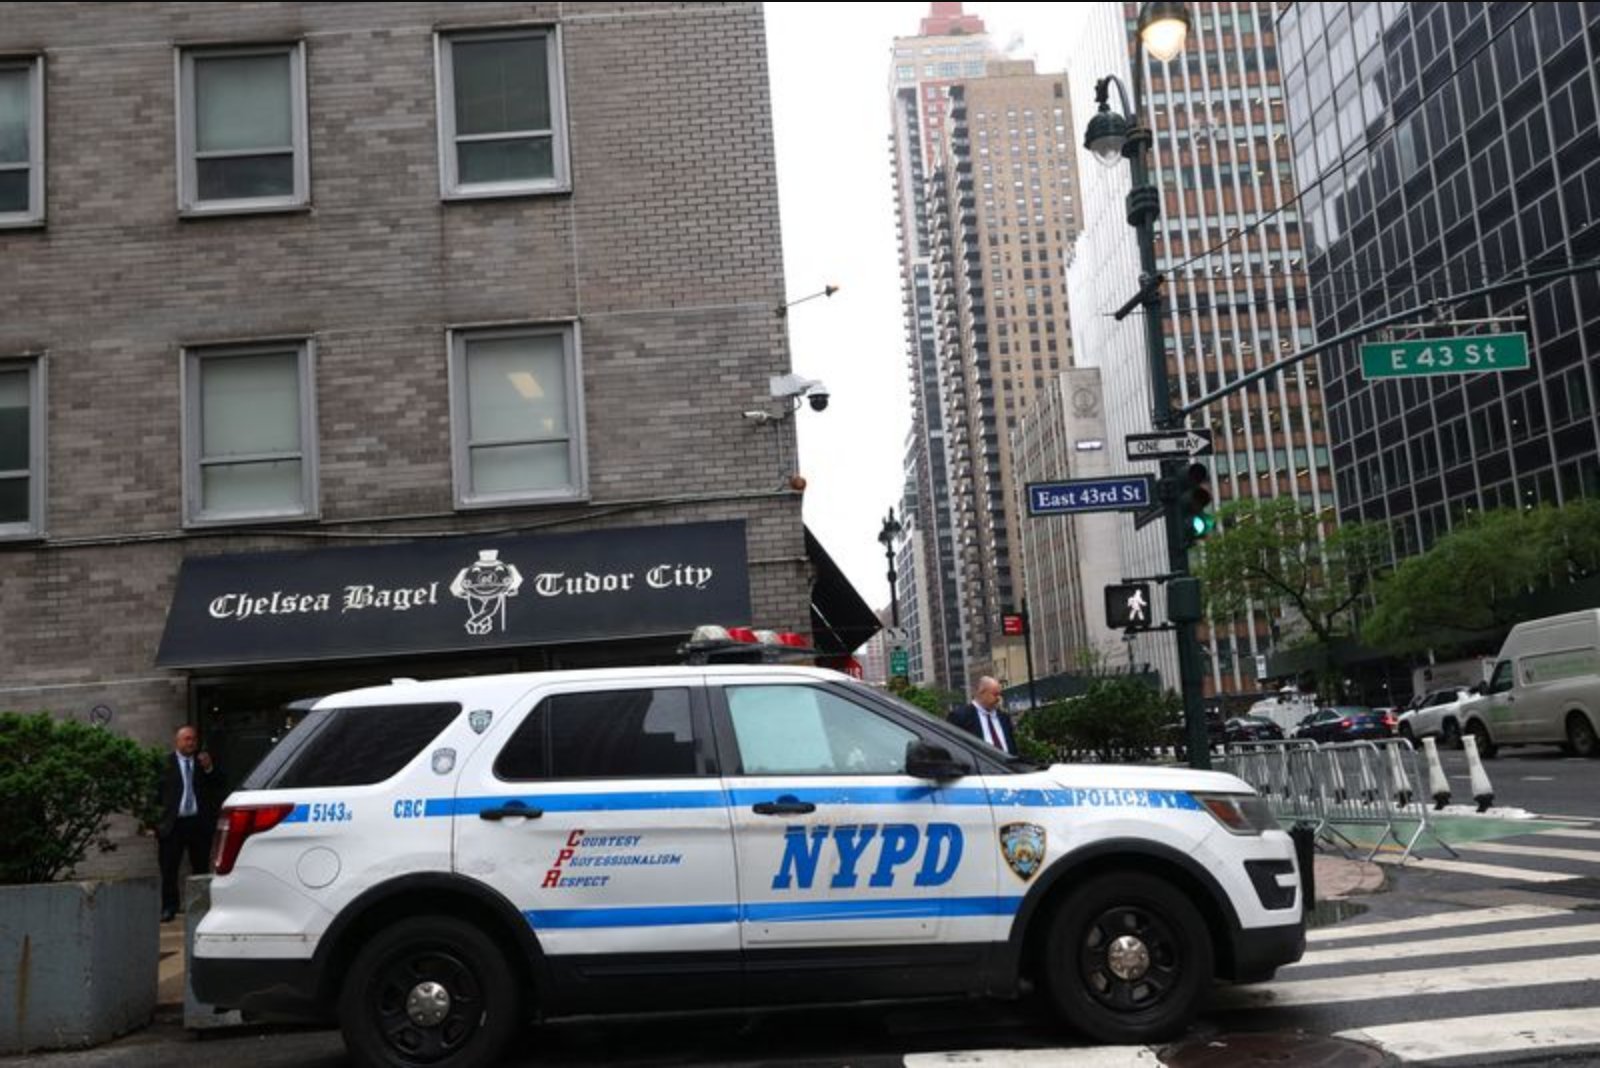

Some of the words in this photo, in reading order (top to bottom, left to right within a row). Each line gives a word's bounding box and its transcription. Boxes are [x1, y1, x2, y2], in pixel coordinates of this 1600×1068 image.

[1391, 349, 1407, 370] E
[1416, 346, 1454, 367] 43
[1465, 343, 1496, 365] St
[1137, 440, 1159, 453] ONE
[1175, 438, 1199, 450] WAY
[1038, 491, 1076, 508] East
[1080, 486, 1117, 504] 43rd
[1121, 485, 1141, 501] St
[208, 590, 331, 621] Chelsea
[341, 581, 440, 615] Bagel
[534, 571, 635, 597] Tudor
[646, 563, 713, 590] City
[1075, 788, 1148, 807] POLICE
[393, 799, 423, 819] CRC
[566, 829, 641, 847] COURTESY
[553, 849, 682, 868] PROFESSIONALISM
[771, 823, 964, 889] NYPD
[541, 869, 610, 889] RESPECT
